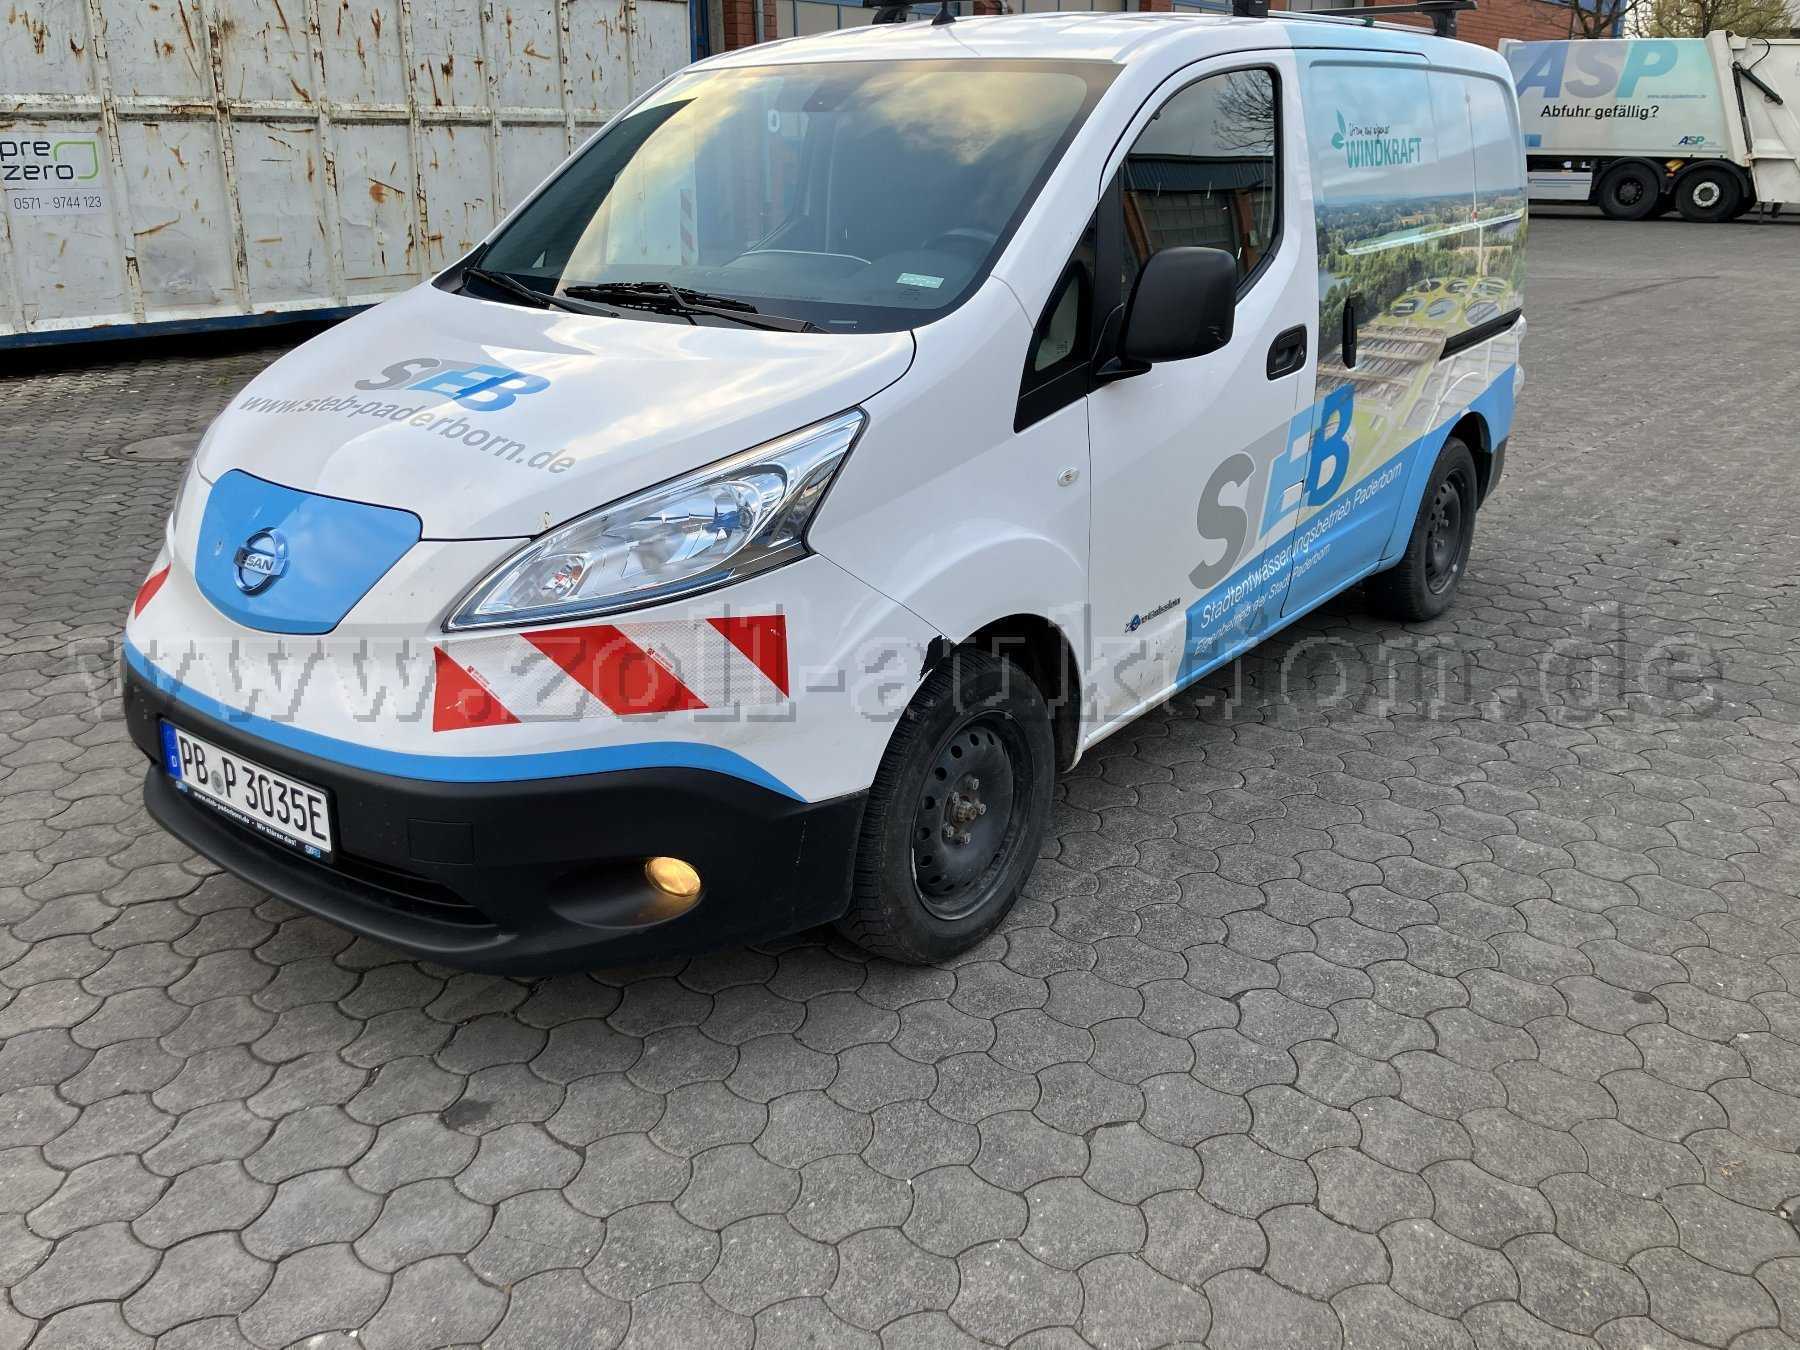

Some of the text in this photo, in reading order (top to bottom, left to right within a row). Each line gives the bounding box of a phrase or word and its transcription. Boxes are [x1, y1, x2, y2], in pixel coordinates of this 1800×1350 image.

[1514, 40, 1679, 98] ASP
[1540, 104, 1660, 120] Abfuhr gefällig?
[0, 141, 51, 161] pre
[1345, 137, 1422, 169] WINDKRAFT
[1678, 135, 1705, 145] ASP
[2, 164, 74, 180] zero
[14, 197, 42, 210] 0571
[53, 196, 81, 209] 9744
[84, 195, 102, 208] 123
[239, 393, 577, 475] www.steb-paderborn.de
[1200, 461, 1403, 629] Stadtentwässerungsbetrieb Paderborn
[178, 735, 327, 841] PB P 3035E
